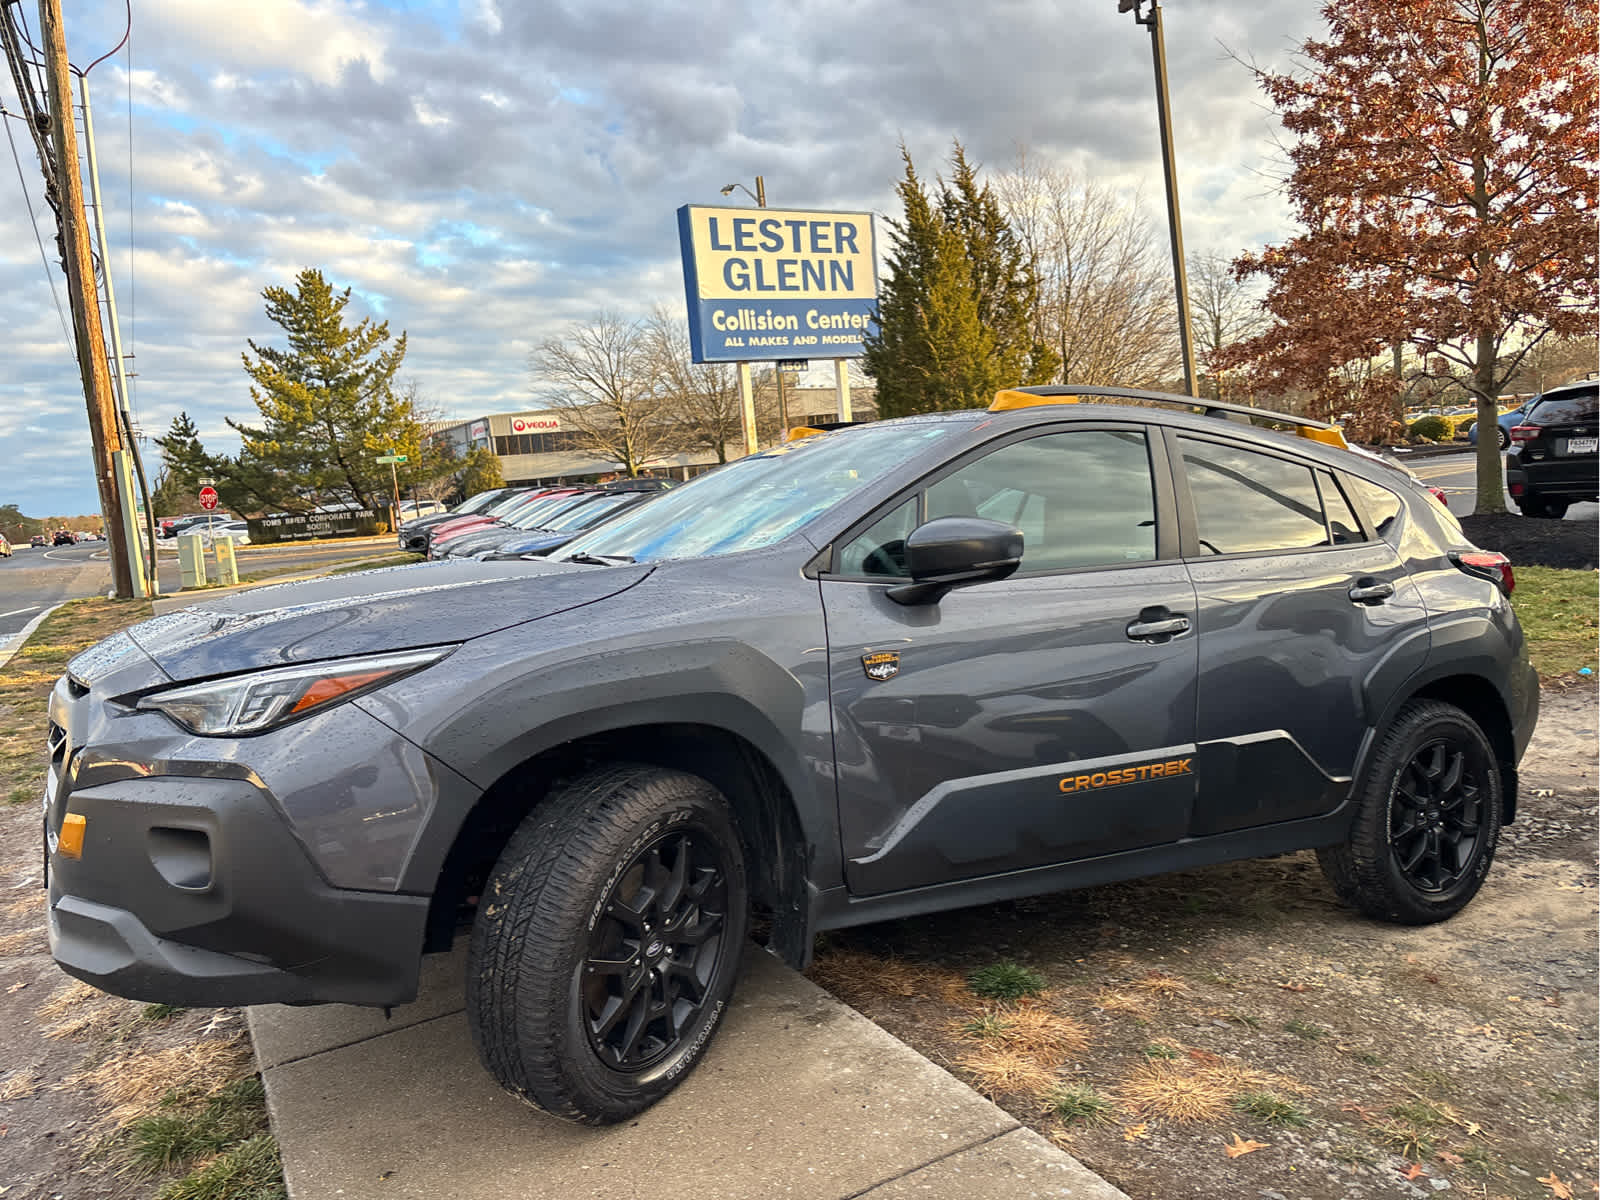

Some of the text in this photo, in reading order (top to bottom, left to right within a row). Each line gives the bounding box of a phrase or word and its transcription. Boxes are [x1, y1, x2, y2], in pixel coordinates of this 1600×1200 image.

[709, 217, 859, 254] LESTER
[722, 257, 854, 292] GLENN
[712, 308, 870, 331] Collision Center
[724, 337, 745, 347] ALL
[749, 335, 789, 346] MAKES
[793, 335, 818, 345] AND
[200, 494, 217, 503] STOP
[308, 511, 352, 523] CORPORATE
[355, 509, 375, 518] PARK
[306, 522, 330, 531] SOUTH
[1058, 758, 1193, 793] CROSSTREK
